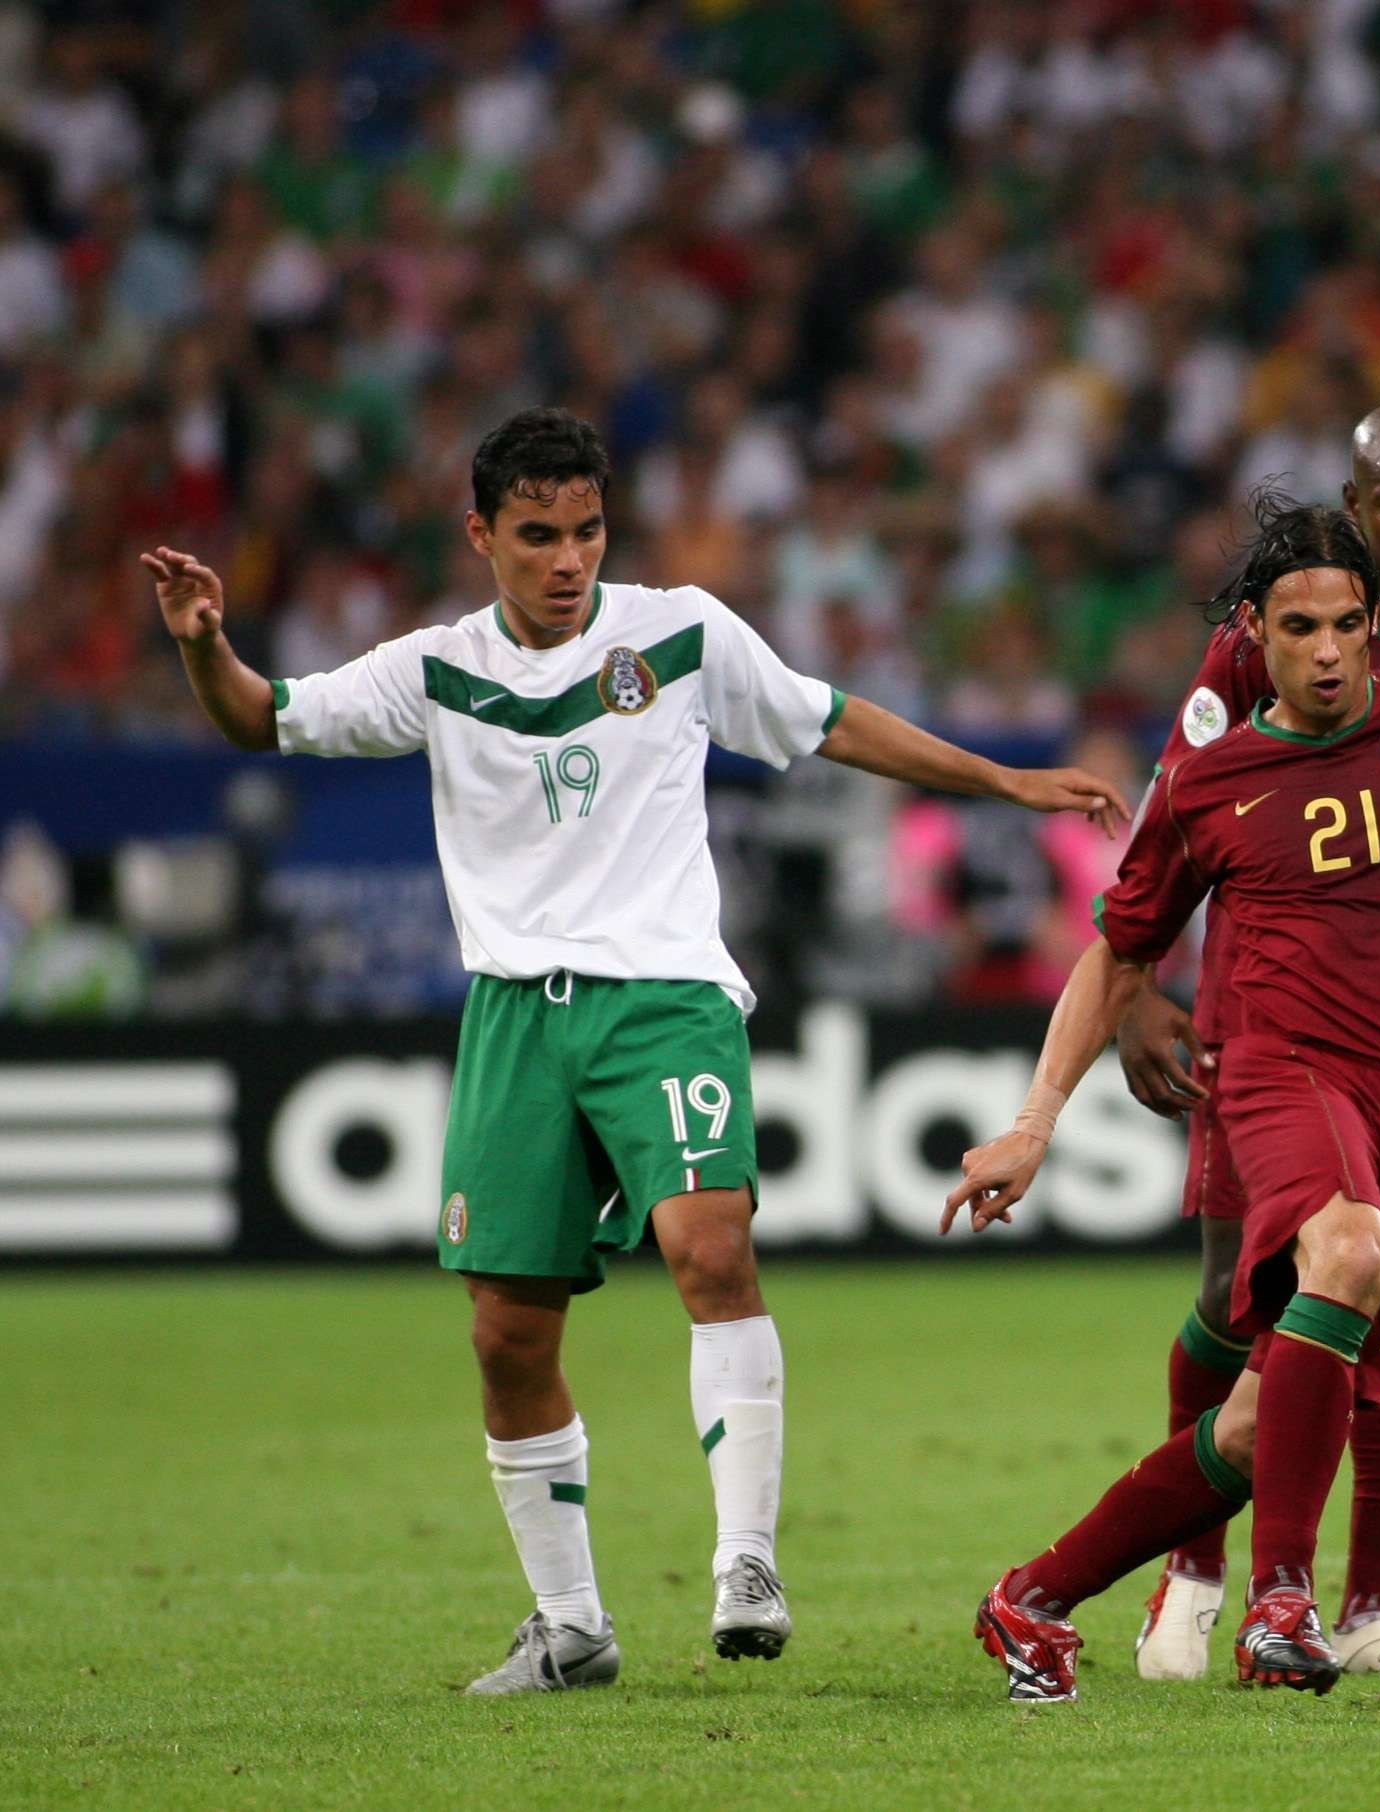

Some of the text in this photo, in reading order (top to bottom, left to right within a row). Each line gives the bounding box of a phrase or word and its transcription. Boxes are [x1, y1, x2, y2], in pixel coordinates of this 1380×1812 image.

[533, 744, 601, 825] 19
[269, 1000, 1190, 1249] adas
[661, 1073, 731, 1142] 19
